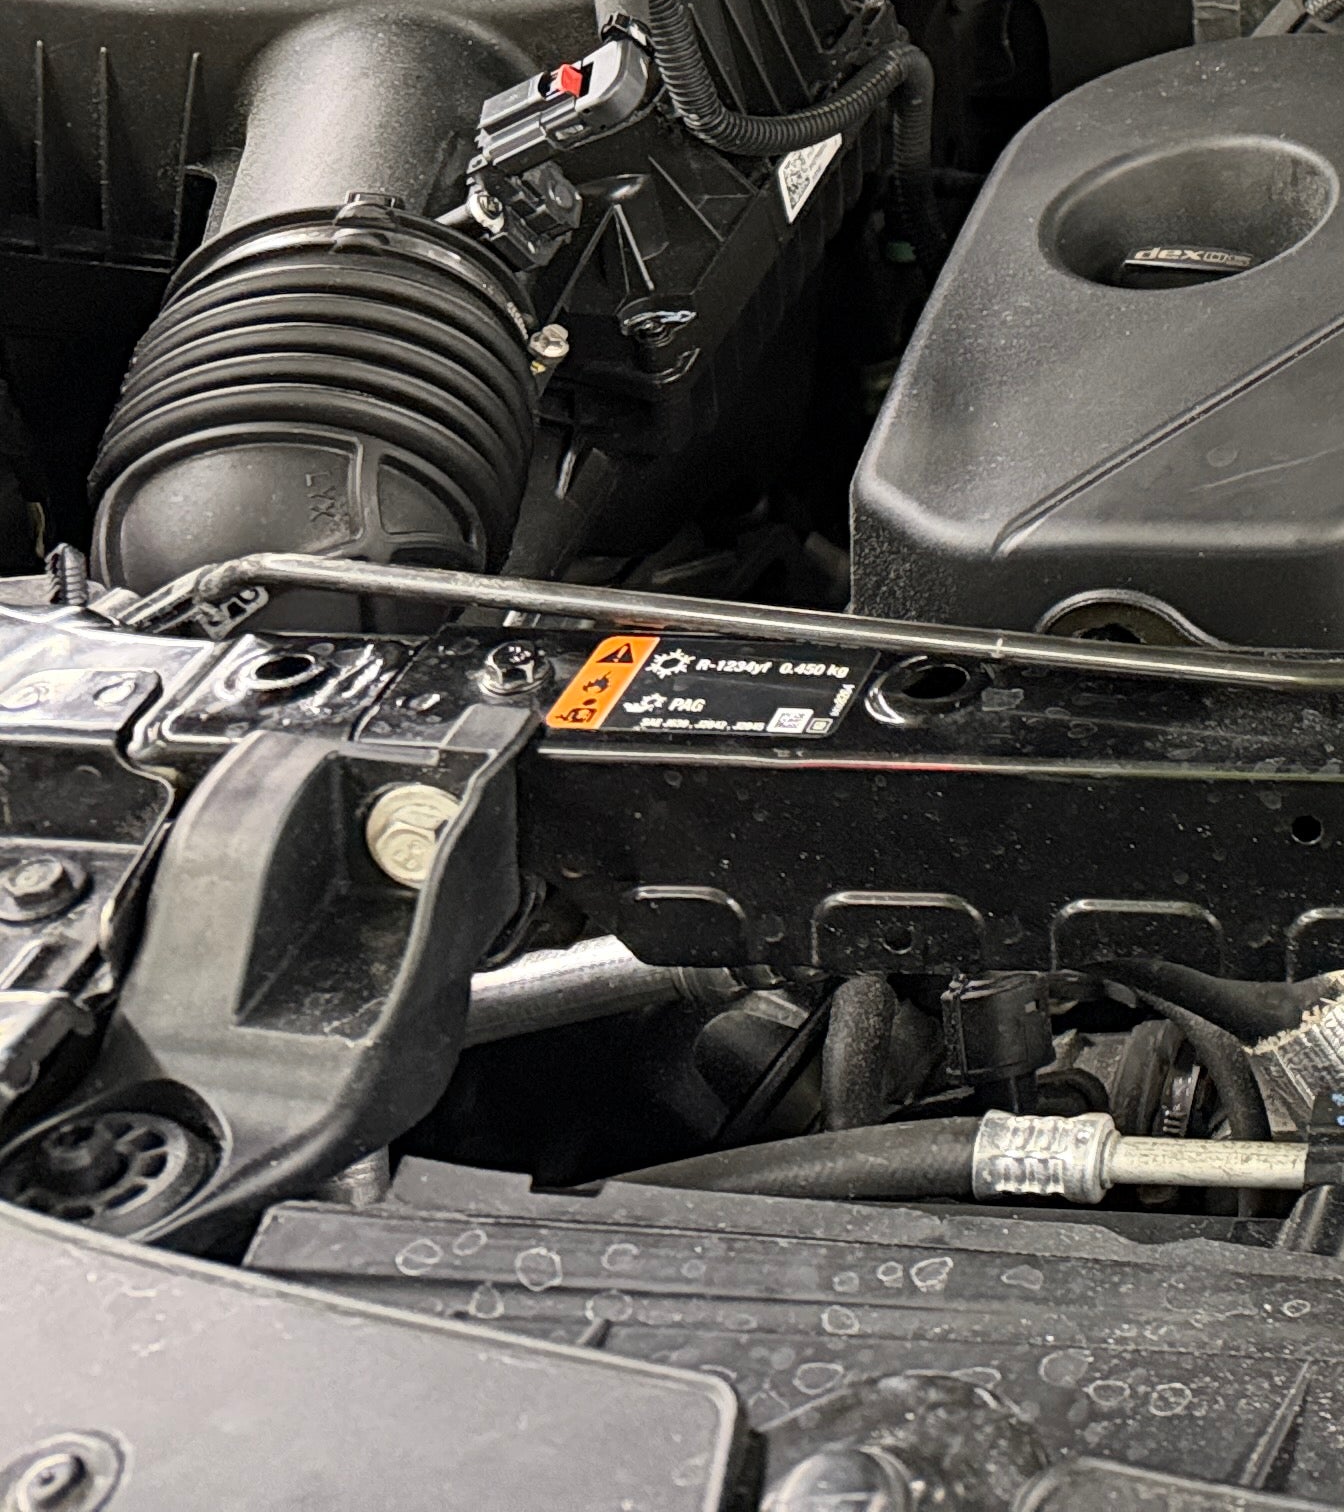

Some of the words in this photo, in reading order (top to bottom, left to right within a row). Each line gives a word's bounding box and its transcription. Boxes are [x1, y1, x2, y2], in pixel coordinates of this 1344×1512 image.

[696, 657, 772, 675] R-1234yf
[779, 662, 826, 676] 0.450
[827, 664, 850, 679] kg
[668, 698, 706, 713] PAG
